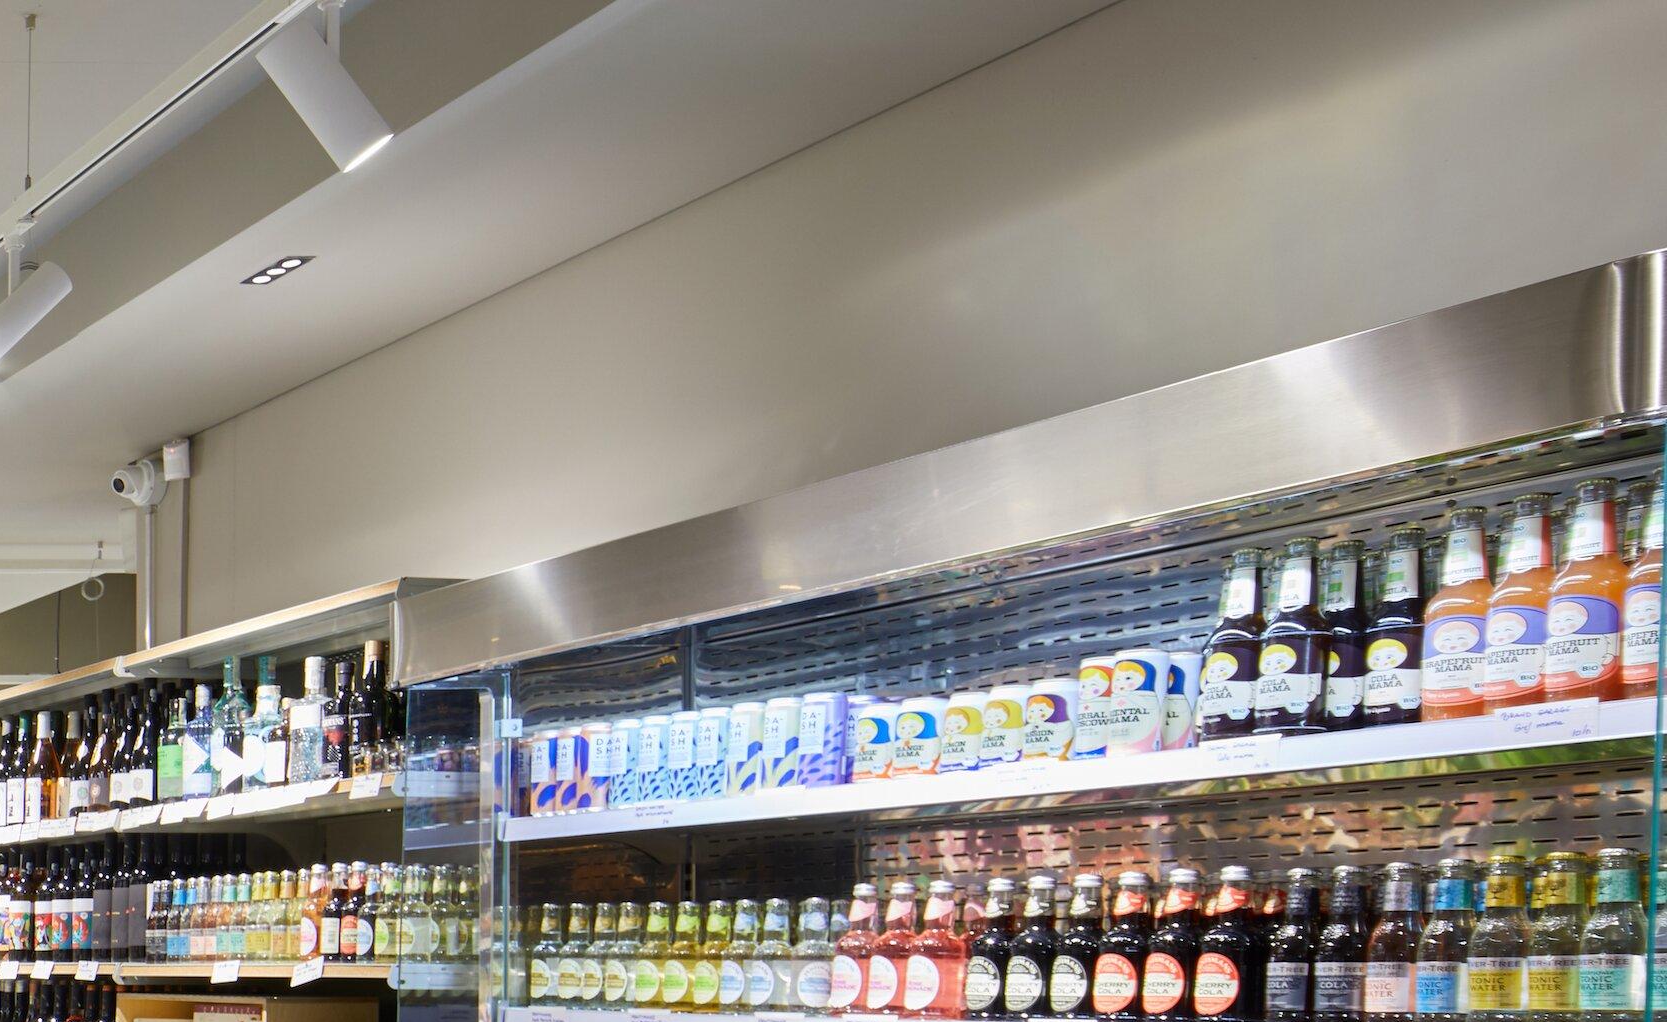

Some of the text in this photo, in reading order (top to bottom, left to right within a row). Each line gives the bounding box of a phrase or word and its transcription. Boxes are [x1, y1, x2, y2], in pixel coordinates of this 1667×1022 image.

[1434, 662, 1472, 673] MAMA
[1261, 678, 1288, 689] COLA
[1371, 674, 1399, 686] COLA
[1259, 684, 1292, 695] MAMA
[1368, 681, 1404, 692] MAMA
[1320, 980, 1348, 990] COLA
[1471, 976, 1505, 985] TONIC
[1471, 984, 1507, 993] WATER
